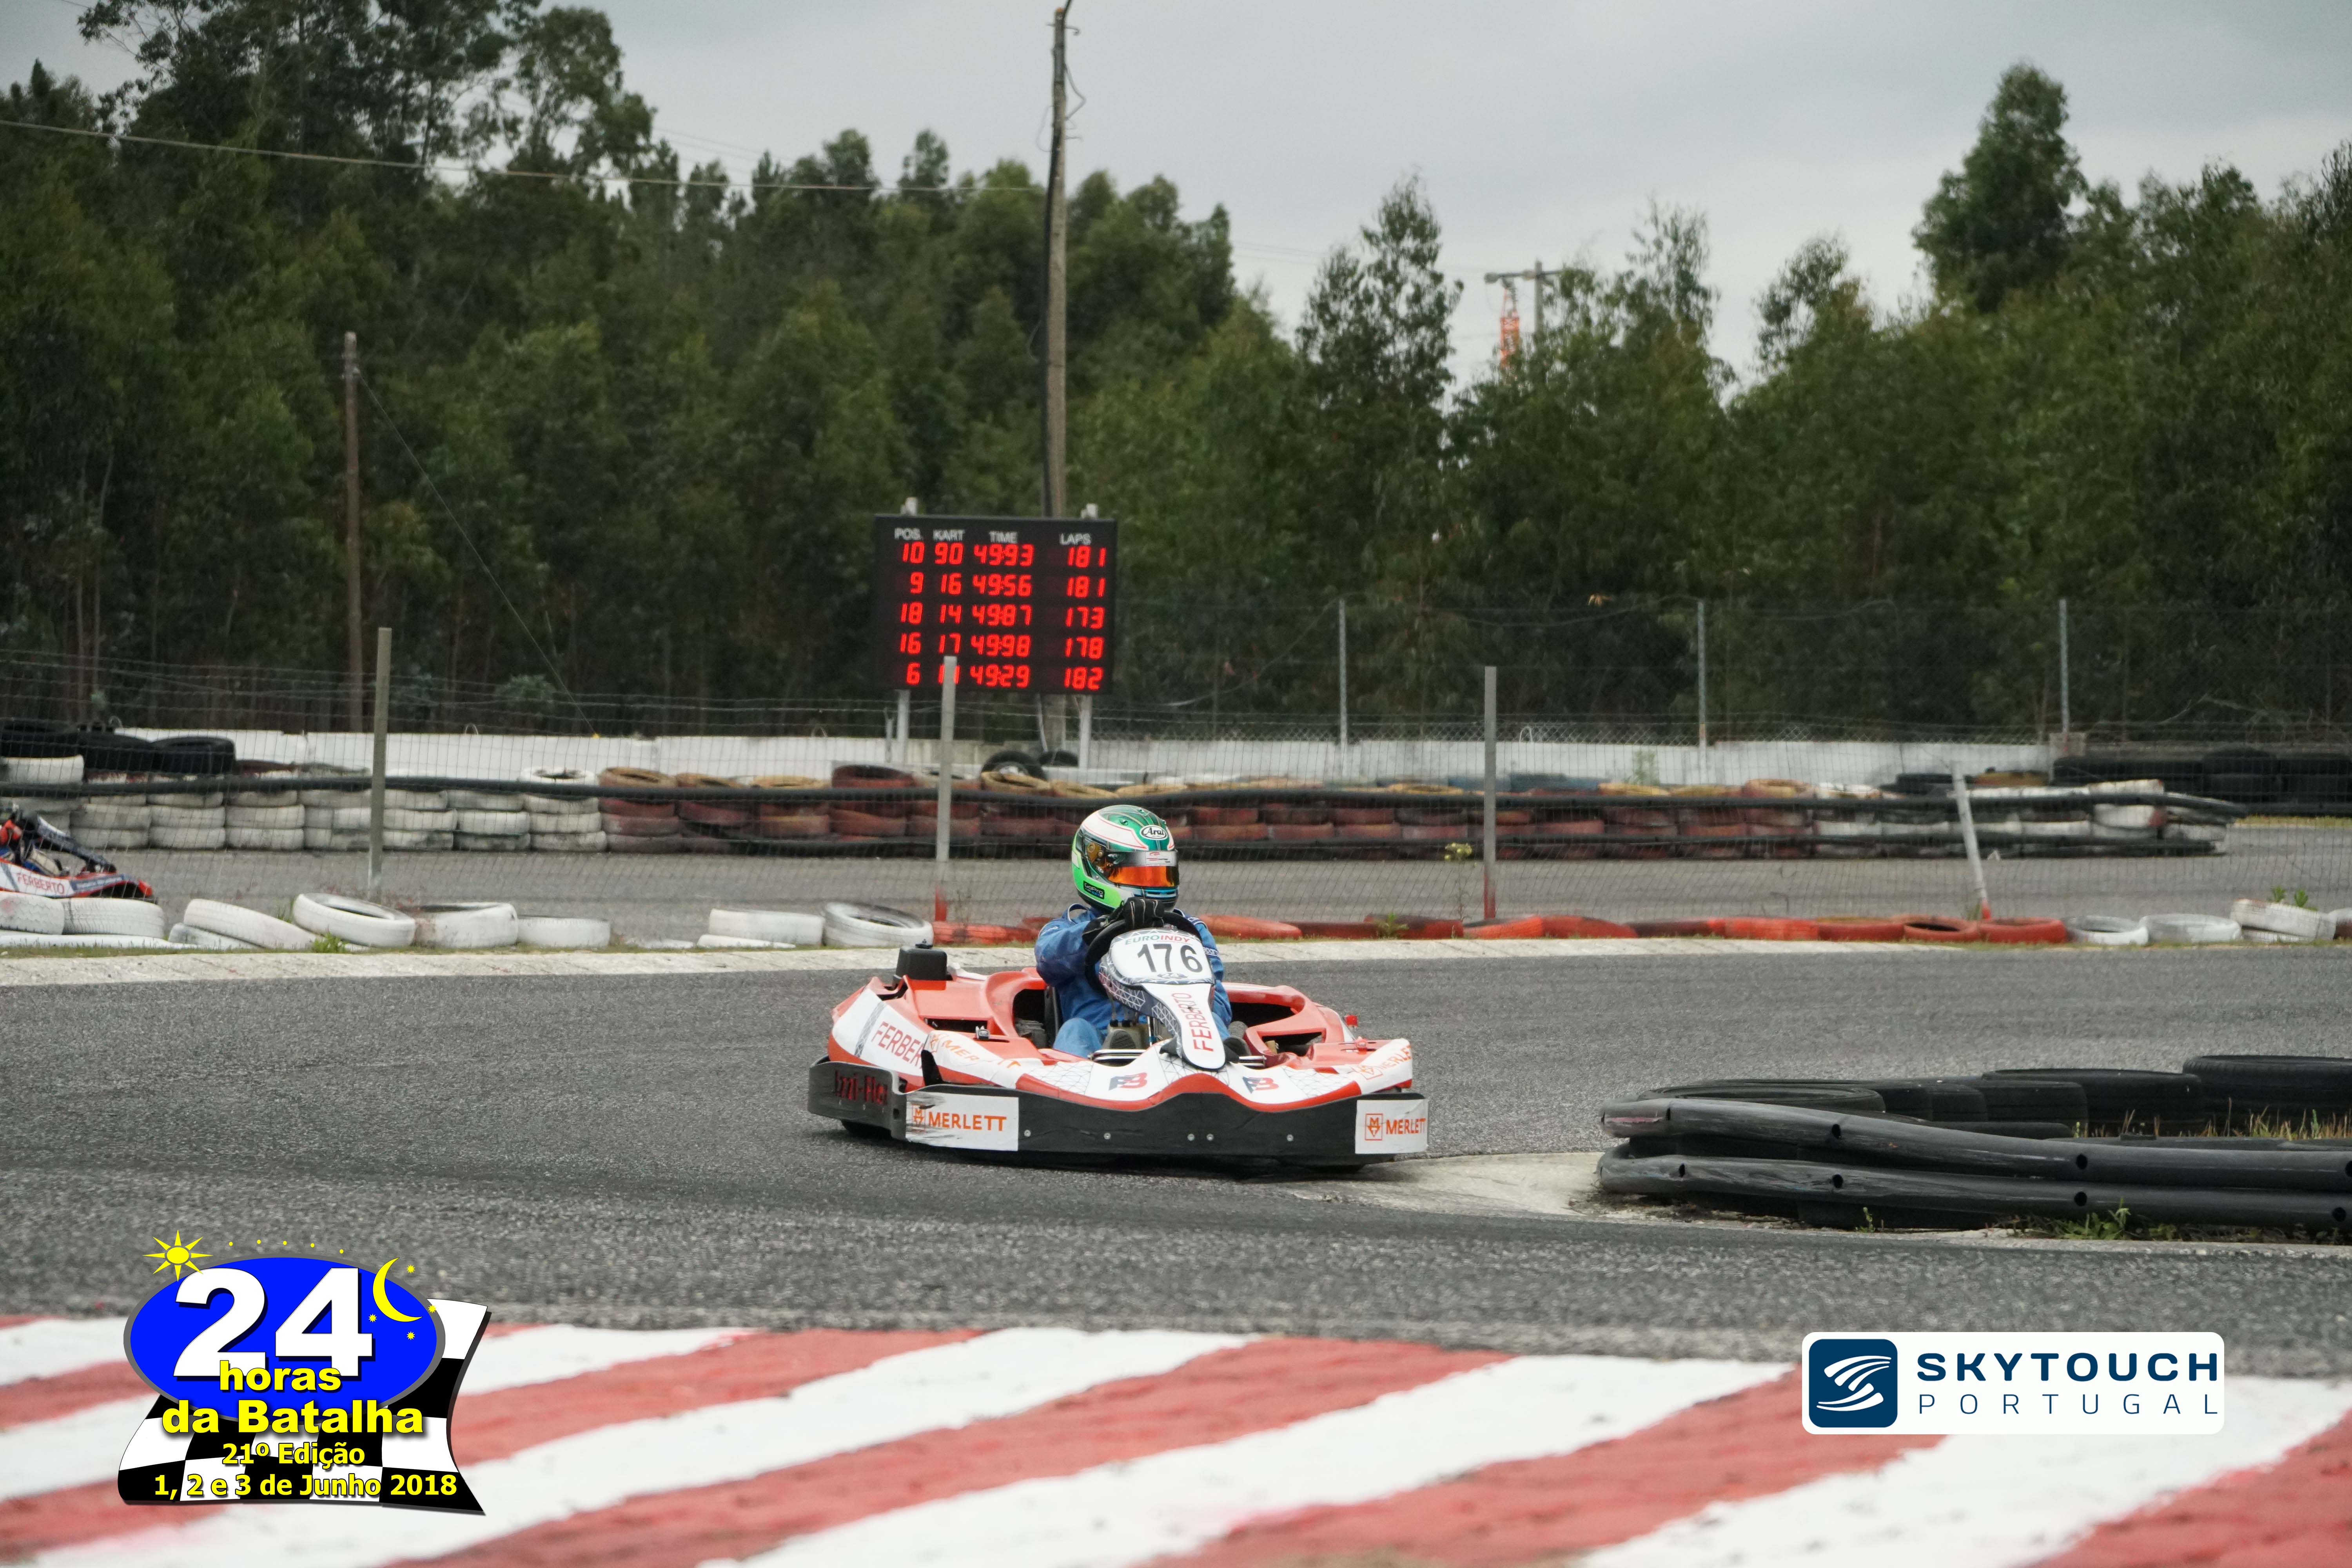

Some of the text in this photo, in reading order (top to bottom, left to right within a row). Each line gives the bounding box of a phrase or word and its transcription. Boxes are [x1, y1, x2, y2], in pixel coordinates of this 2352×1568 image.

[933, 530, 965, 541] KART
[989, 531, 1018, 543] TIME
[1060, 533, 1091, 545] LAPS
[902, 541, 924, 563] 10
[935, 542, 964, 564] 90
[1067, 545, 1106, 568] 181
[910, 572, 924, 593] 9
[941, 573, 962, 595] 16
[1066, 575, 1106, 598] 181
[901, 602, 923, 624] 18
[939, 604, 962, 624] 14
[1065, 606, 1105, 629] 173
[900, 632, 921, 654] 16
[938, 633, 961, 654] 17
[1065, 637, 1104, 659] 178
[906, 662, 920, 685] 6
[1064, 666, 1103, 690] 182
[1144, 827, 1164, 835] Arai
[16, 873, 65, 895] FERBERTO
[1085, 883, 1103, 895] GoPro
[1125, 935, 1191, 945] EUROINDY
[1137, 944, 1203, 973] 176
[1171, 993, 1214, 1052] FERBERTO
[928, 1111, 1007, 1131] MERLETT
[1386, 1118, 1426, 1134] MERLETT
